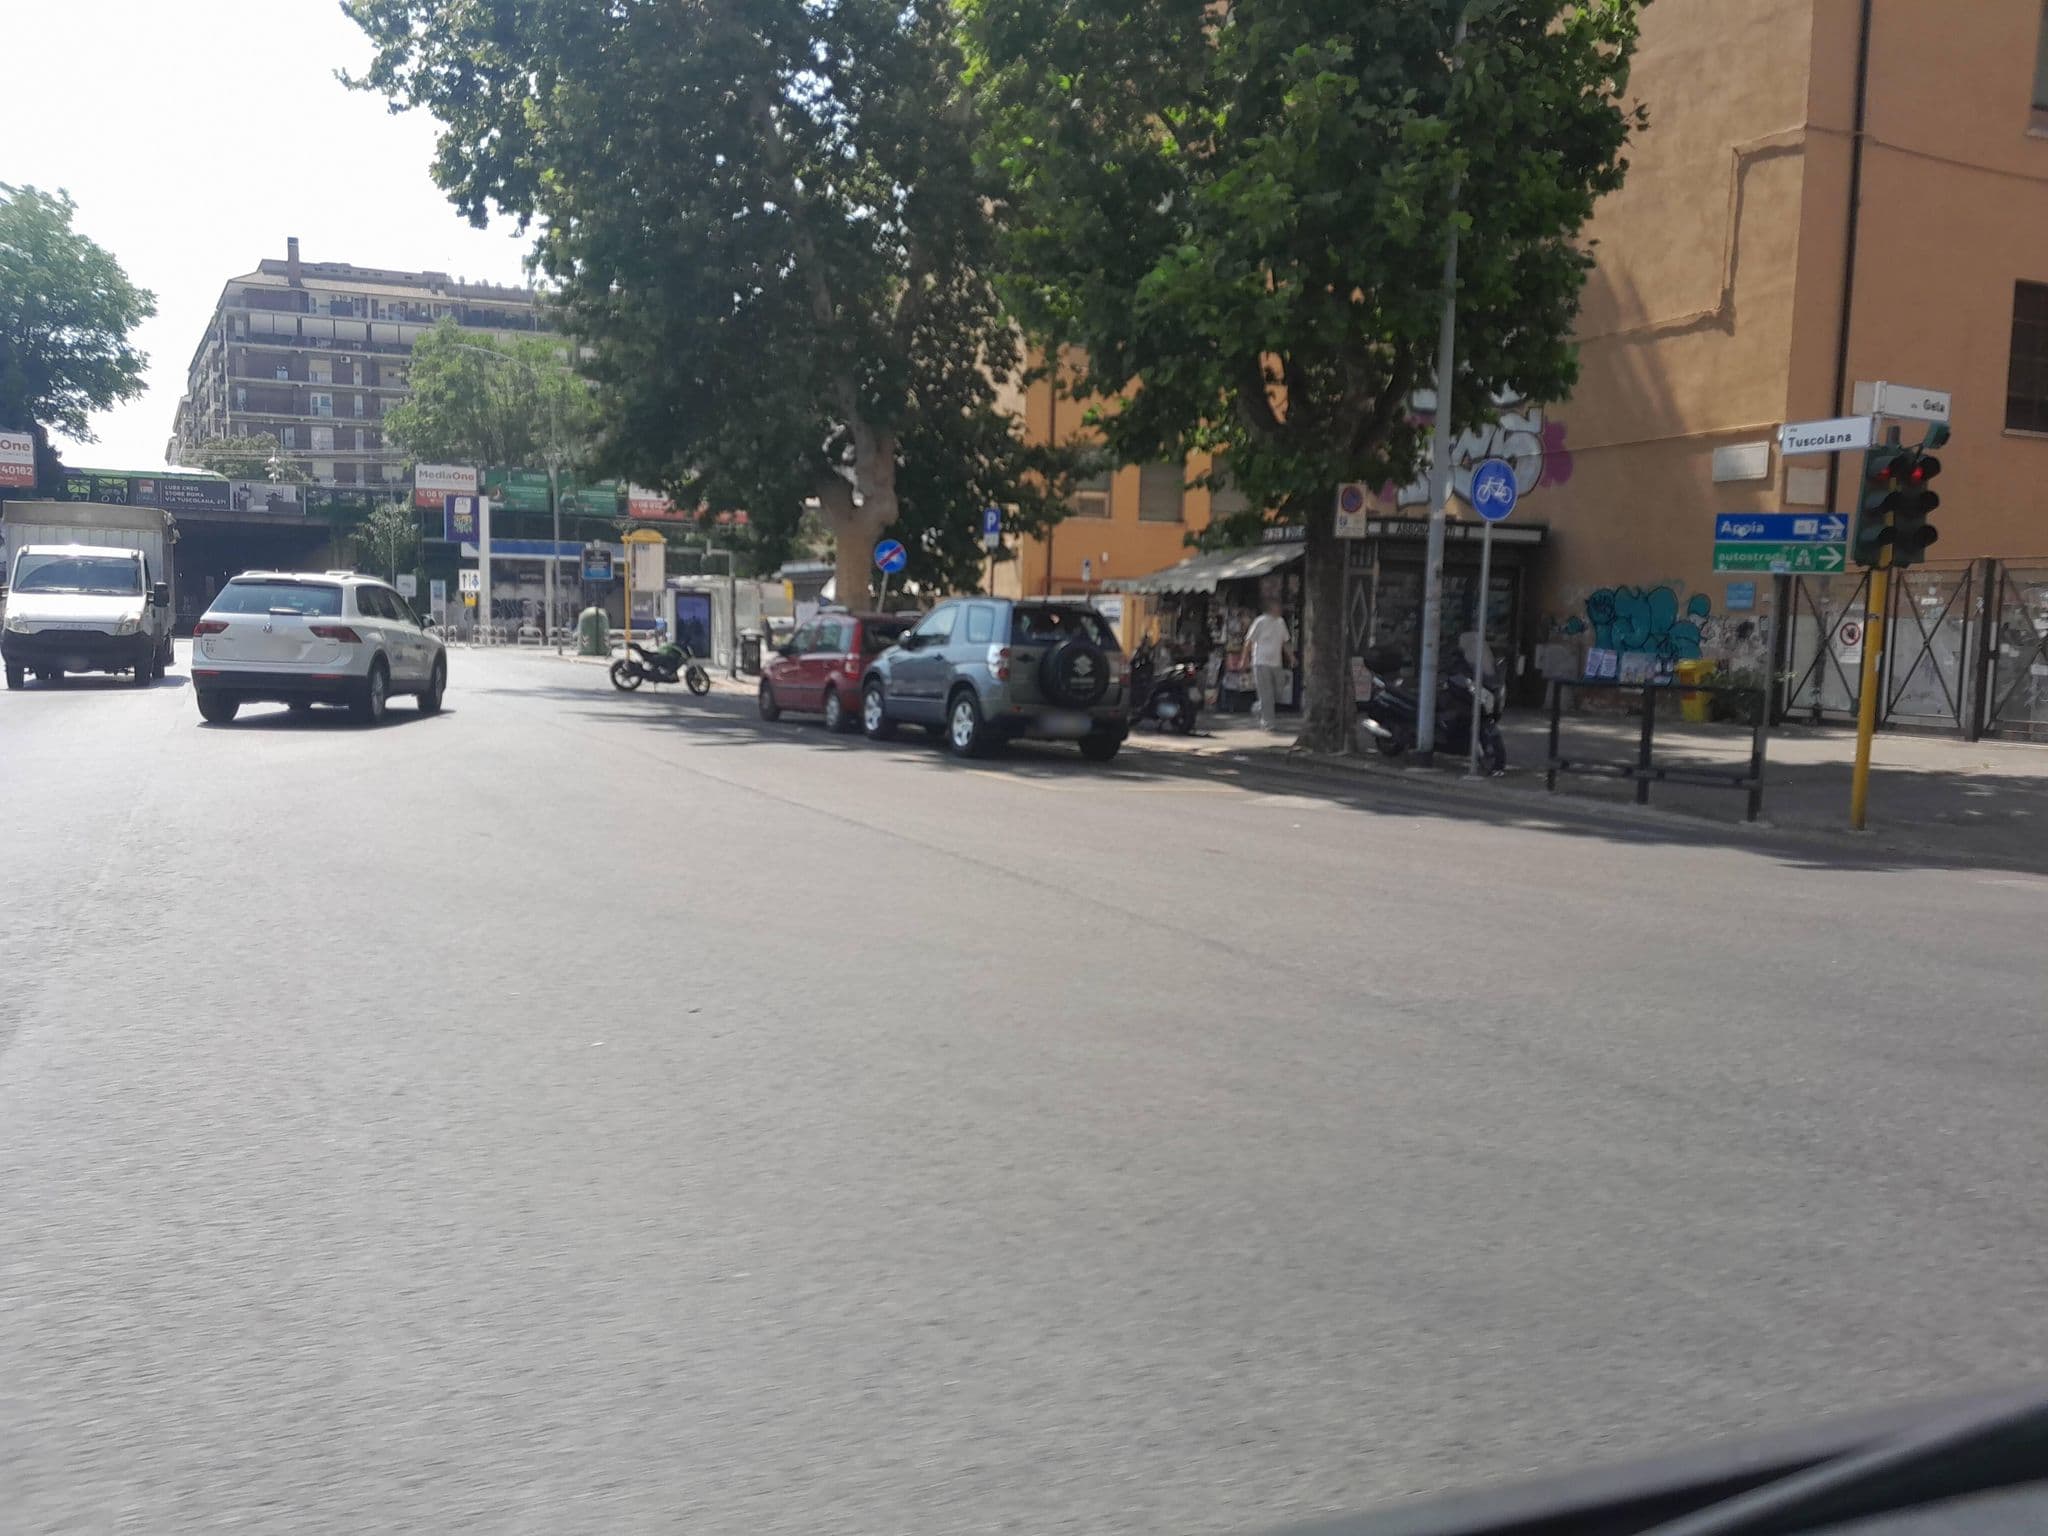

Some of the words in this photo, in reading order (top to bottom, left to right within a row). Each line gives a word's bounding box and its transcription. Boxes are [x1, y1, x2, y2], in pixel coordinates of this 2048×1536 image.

[1923, 399, 1945, 413] Gela
[0, 439, 31, 451] One
[1788, 432, 1852, 448] Tuscolana
[419, 469, 475, 481] MediaOne
[987, 511, 997, 531] P
